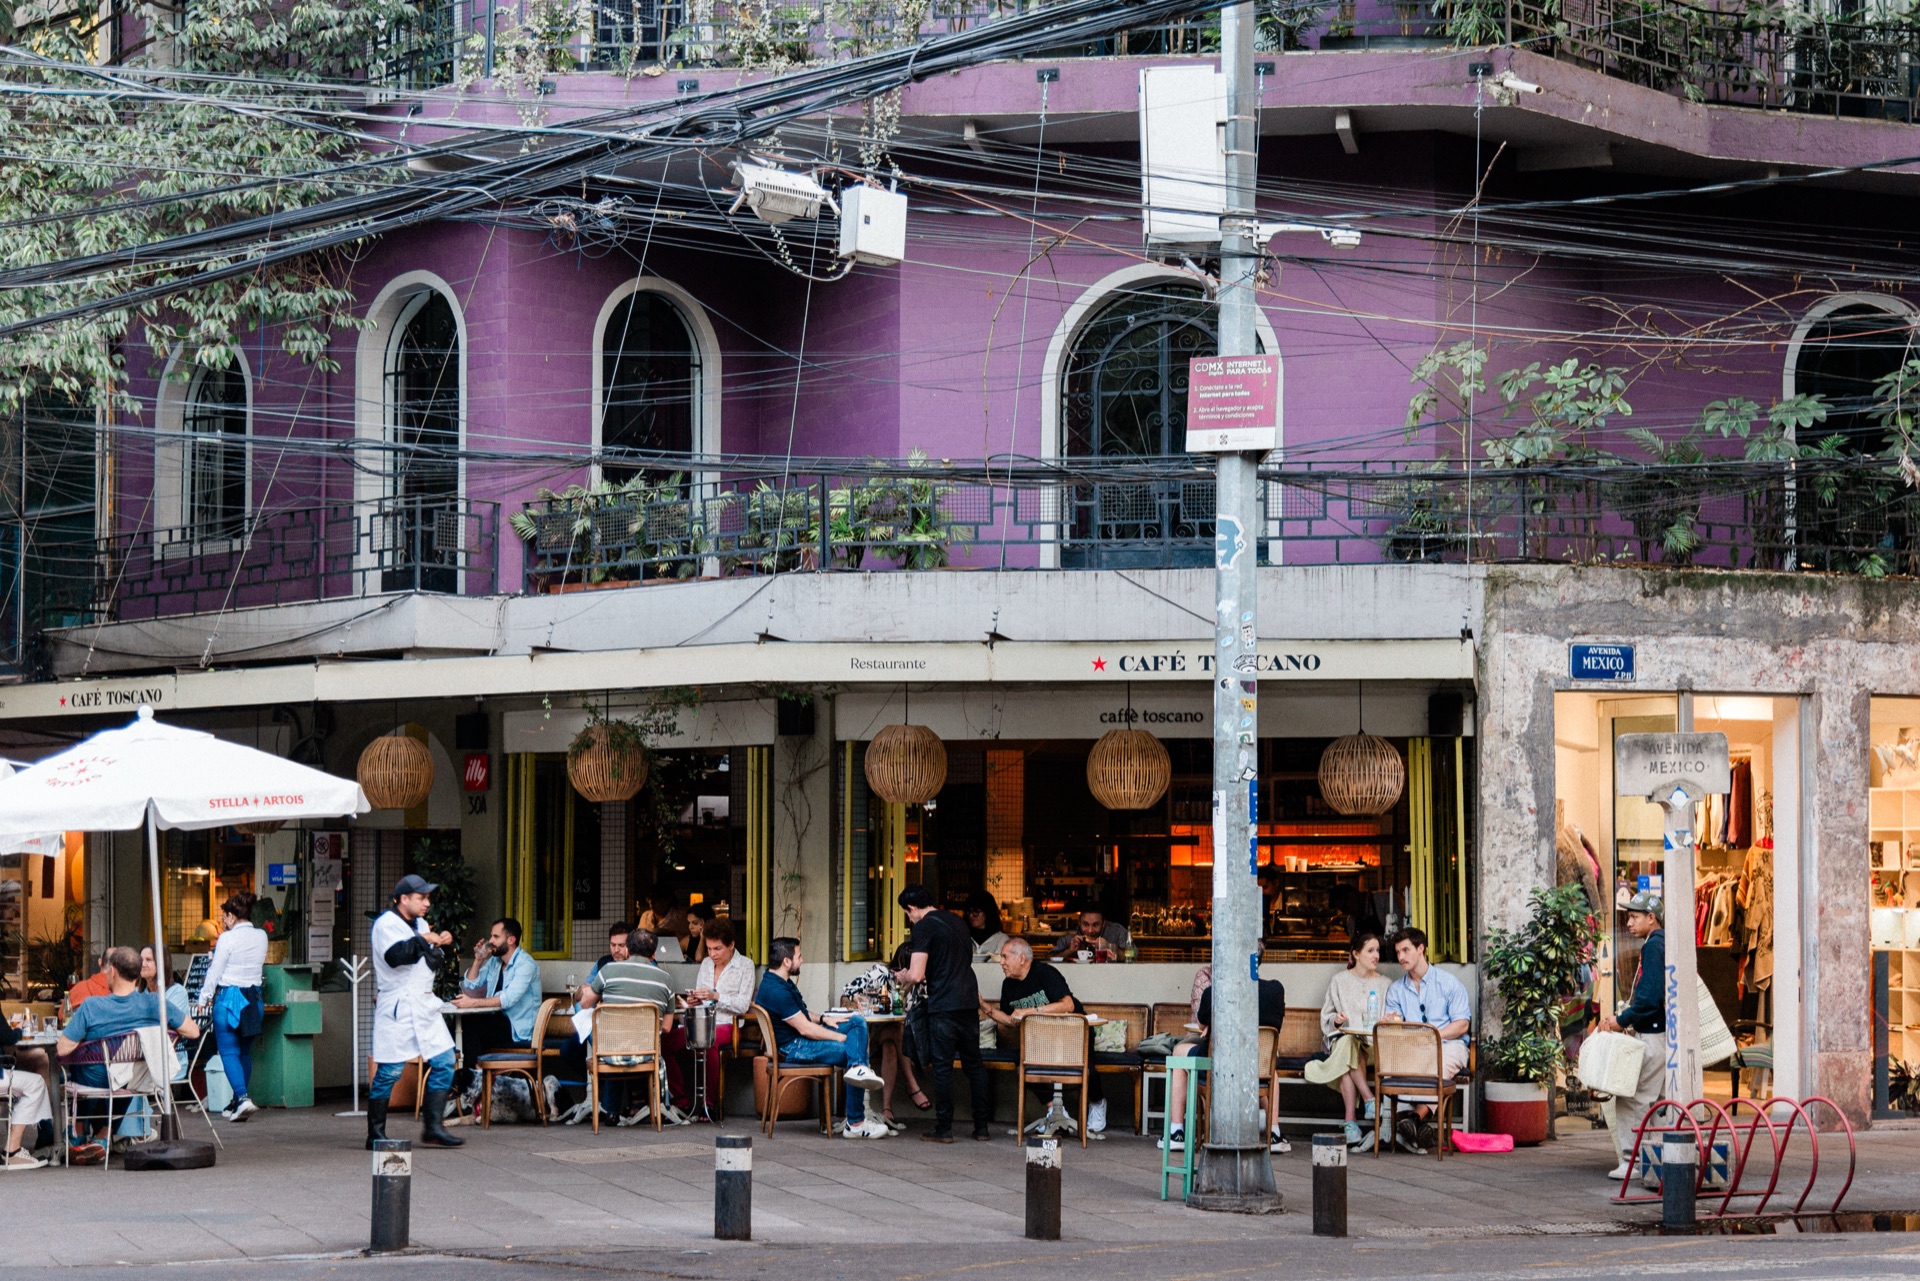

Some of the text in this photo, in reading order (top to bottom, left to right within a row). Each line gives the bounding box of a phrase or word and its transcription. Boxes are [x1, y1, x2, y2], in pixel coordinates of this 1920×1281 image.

[1194, 362, 1223, 372] CDMX
[1247, 366, 1272, 374] TODAS
[1588, 647, 1621, 656] AVENIDA
[850, 657, 926, 669] Restaurante
[1118, 650, 1186, 672] CAFÉ
[1197, 654, 1321, 671] TCANO
[1582, 656, 1624, 670] MEXICO
[71, 688, 162, 708] CAFÉ TOSCANO
[1100, 708, 1204, 723] caffè toscano
[1649, 742, 1703, 754] AVENIDA
[466, 759, 486, 787] illy
[1649, 761, 1705, 773] MEXICO
[209, 794, 304, 808] STELLA ARTOIS
[468, 795, 487, 815] 30A
